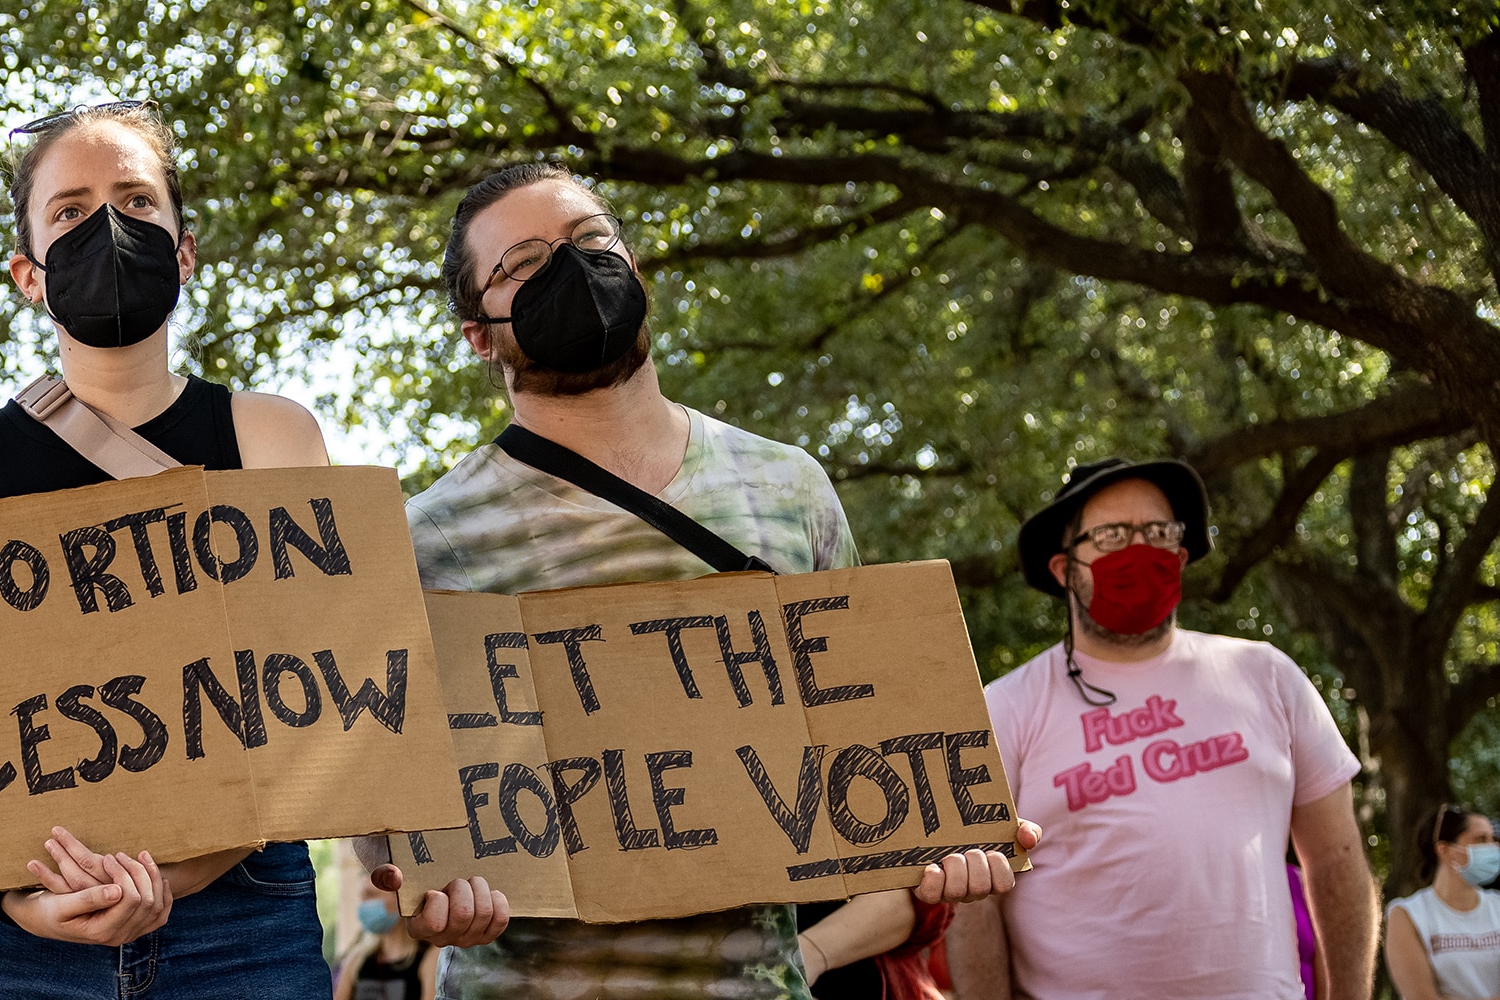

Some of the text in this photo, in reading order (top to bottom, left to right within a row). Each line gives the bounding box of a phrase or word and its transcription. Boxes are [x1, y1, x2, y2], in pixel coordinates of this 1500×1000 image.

[182, 649, 409, 761] NOW
[447, 595, 874, 729] ET THE
[1054, 732, 1249, 812] Ted Cruz
[1081, 695, 1185, 753] Fuck
[408, 730, 1010, 865] EOPLE VOTE
